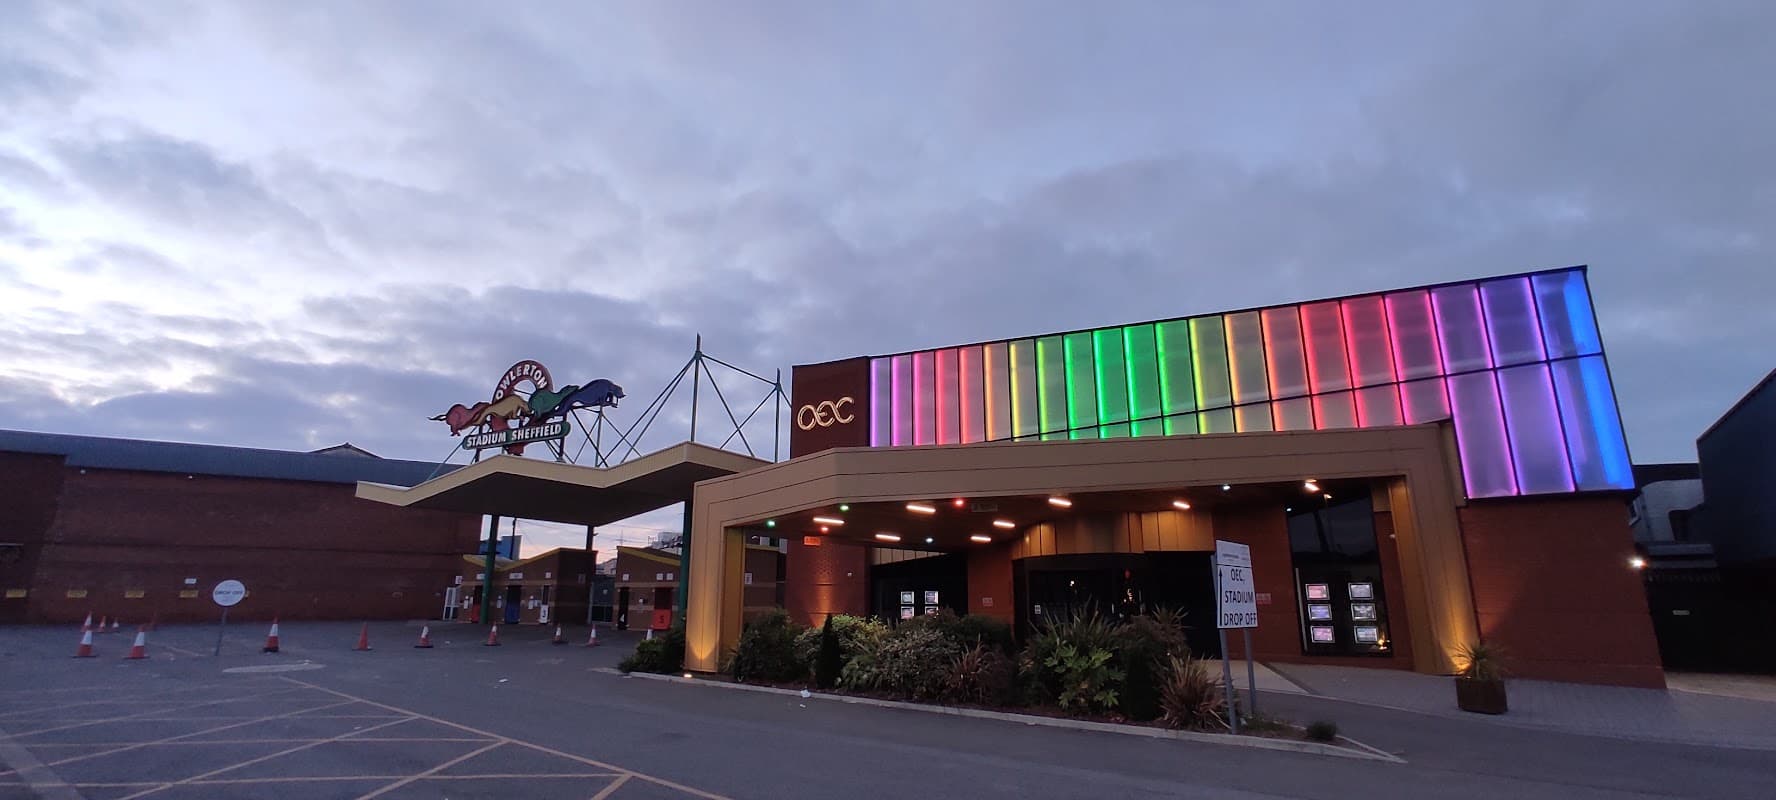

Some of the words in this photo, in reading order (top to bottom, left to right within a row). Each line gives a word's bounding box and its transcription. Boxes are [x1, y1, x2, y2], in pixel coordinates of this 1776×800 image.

[495, 364, 547, 399] OWLERTON
[466, 432, 506, 446] STADIUM
[511, 424, 561, 440] SHEFFIELD
[1224, 591, 1253, 603] STADIUM
[1224, 613, 1243, 625] DROP
[1245, 613, 1256, 625] OFF
